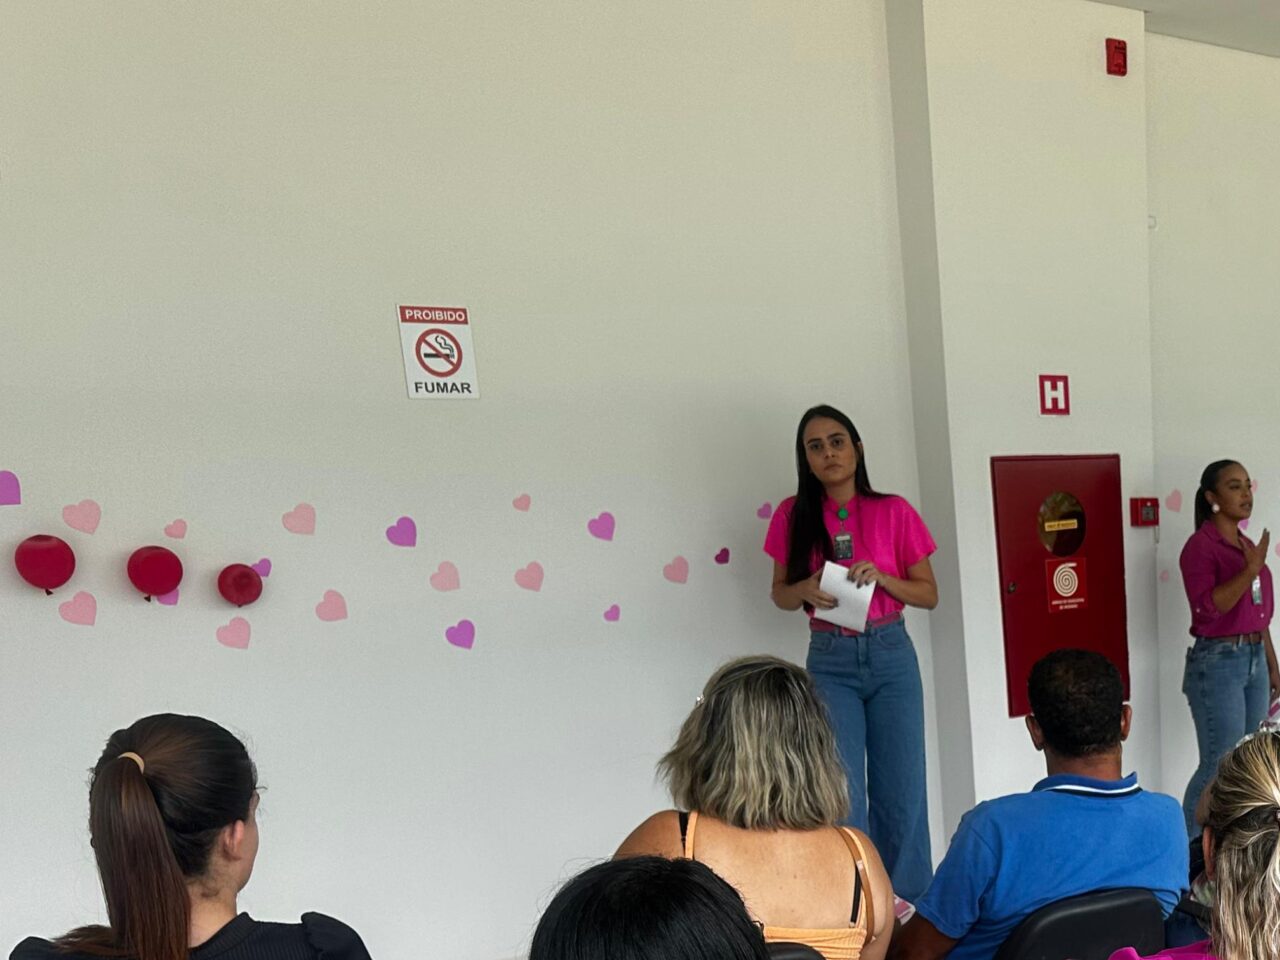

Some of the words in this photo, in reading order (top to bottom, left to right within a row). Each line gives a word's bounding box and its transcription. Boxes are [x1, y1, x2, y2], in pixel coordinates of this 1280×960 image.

[405, 309, 466, 322] PROIBIDO
[414, 381, 472, 394] FUMAR
[1043, 381, 1065, 409] H
